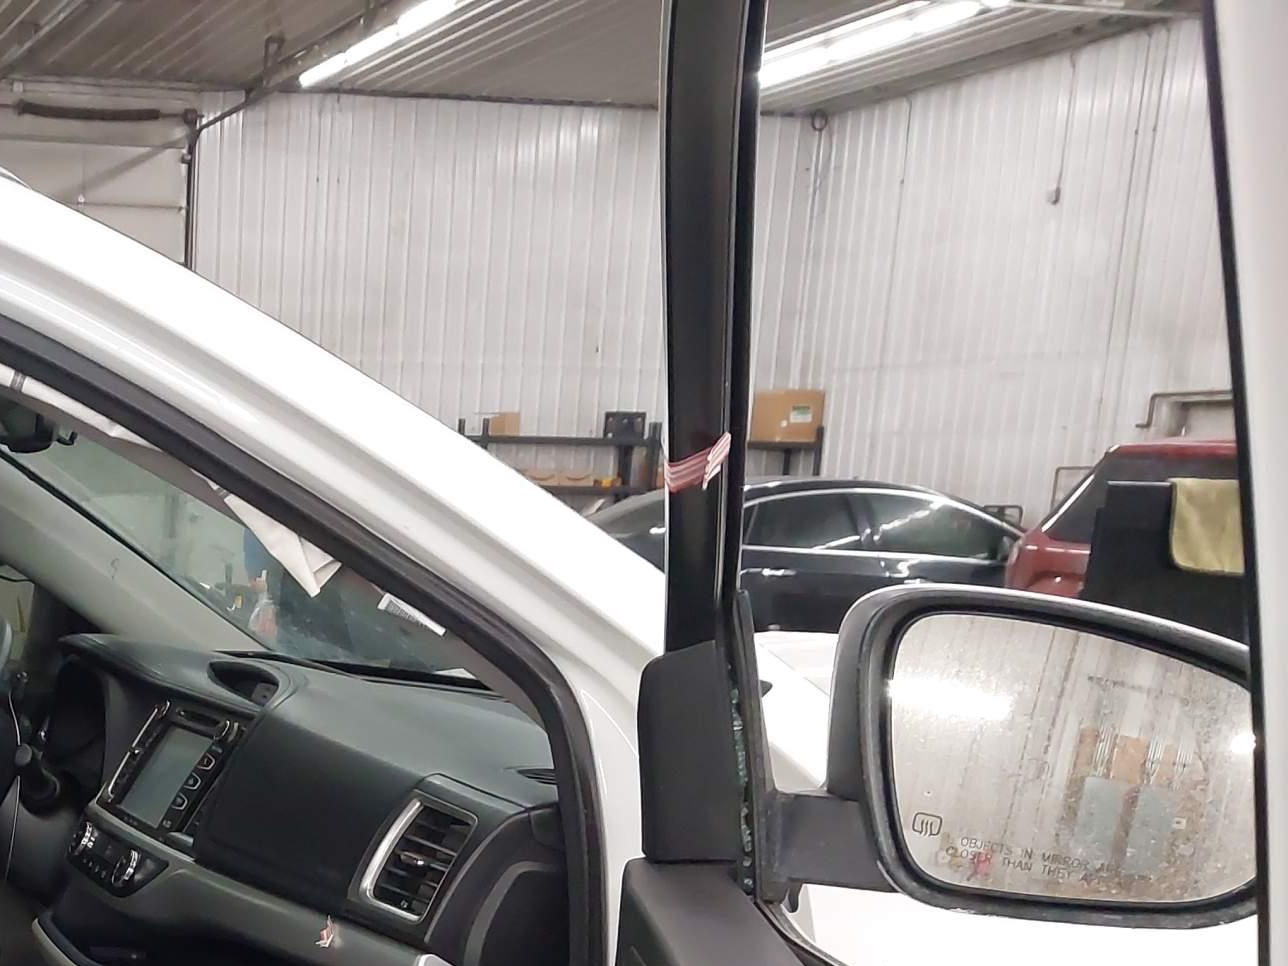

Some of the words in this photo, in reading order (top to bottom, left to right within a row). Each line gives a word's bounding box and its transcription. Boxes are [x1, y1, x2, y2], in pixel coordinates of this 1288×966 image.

[945, 846, 993, 865] CLOSER
[1002, 857, 1033, 872] THAN
[961, 836, 1013, 856] OBJECTS
[1021, 848, 1034, 860] IN
[1041, 851, 1090, 872] MIRROR
